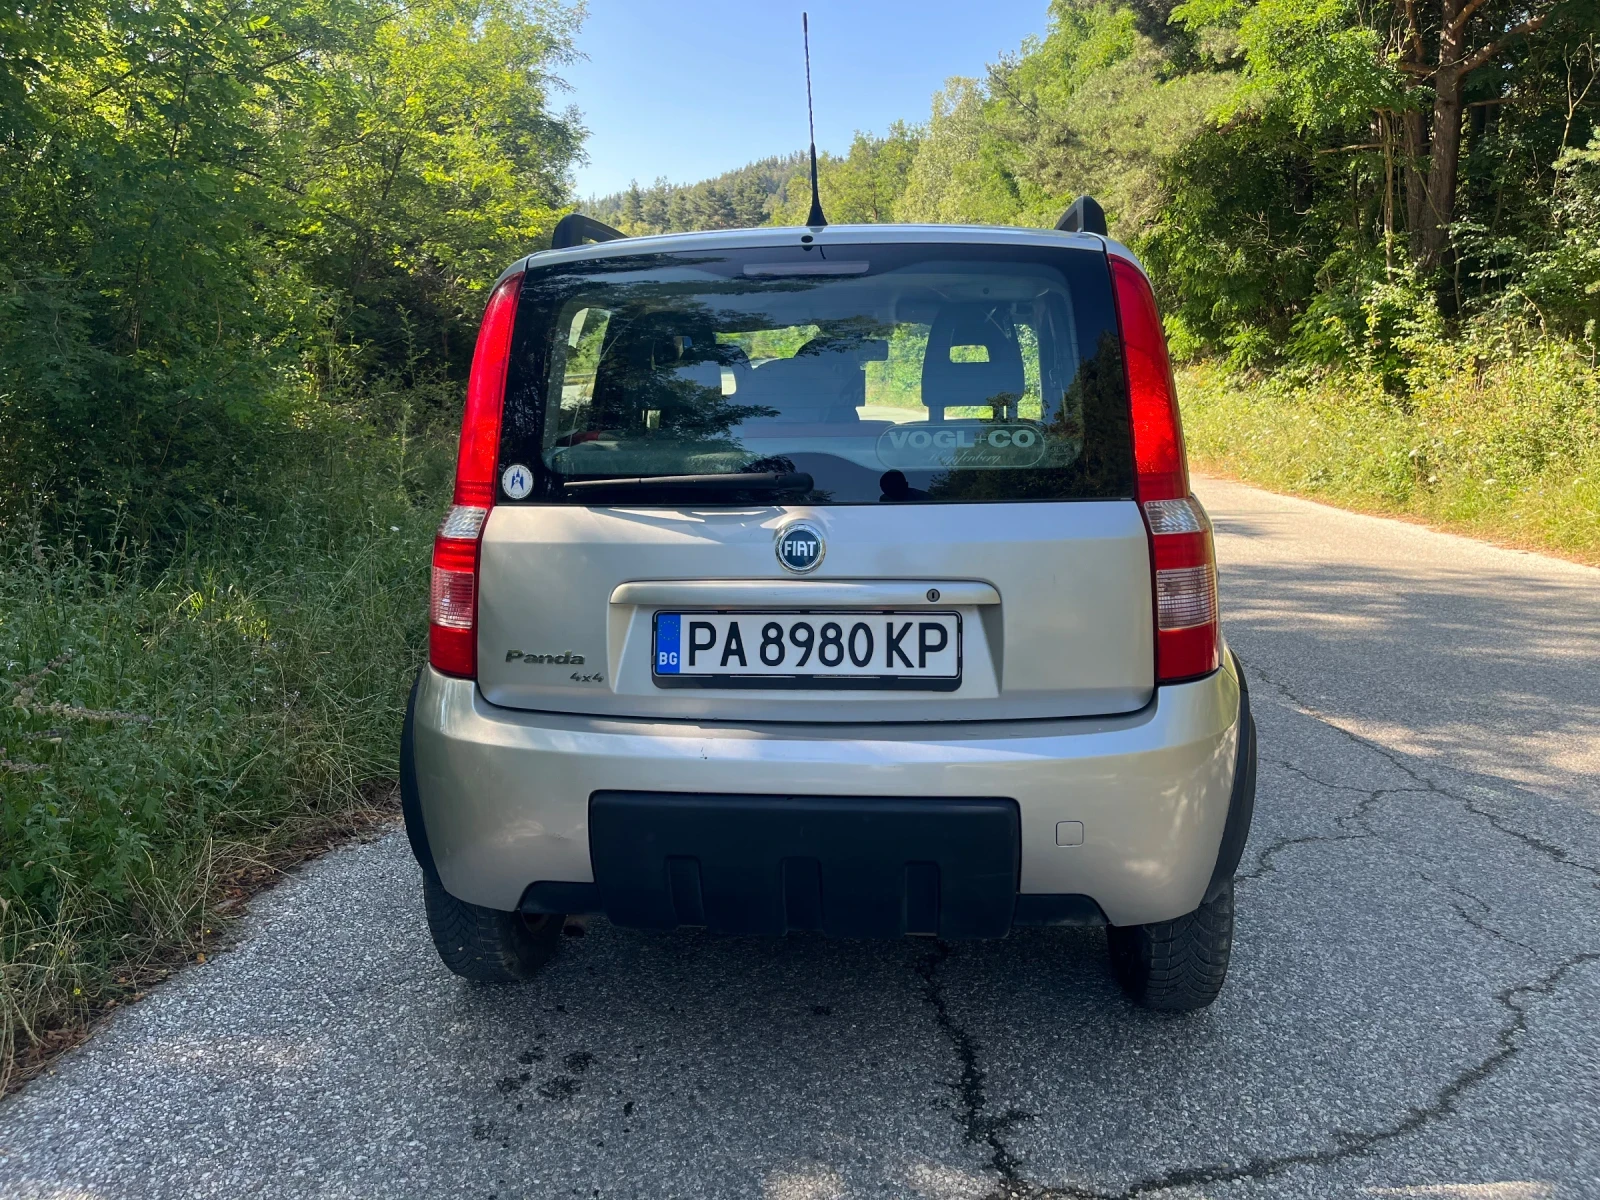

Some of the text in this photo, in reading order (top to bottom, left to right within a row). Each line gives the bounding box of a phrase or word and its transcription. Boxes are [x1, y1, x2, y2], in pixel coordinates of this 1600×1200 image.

[888, 429, 1036, 448] VOGL+CO
[784, 540, 816, 557] FIAT
[688, 621, 949, 669] PA 8980 KP
[505, 649, 585, 665] Panda
[658, 651, 678, 666] BG
[569, 671, 605, 683] 4x4
